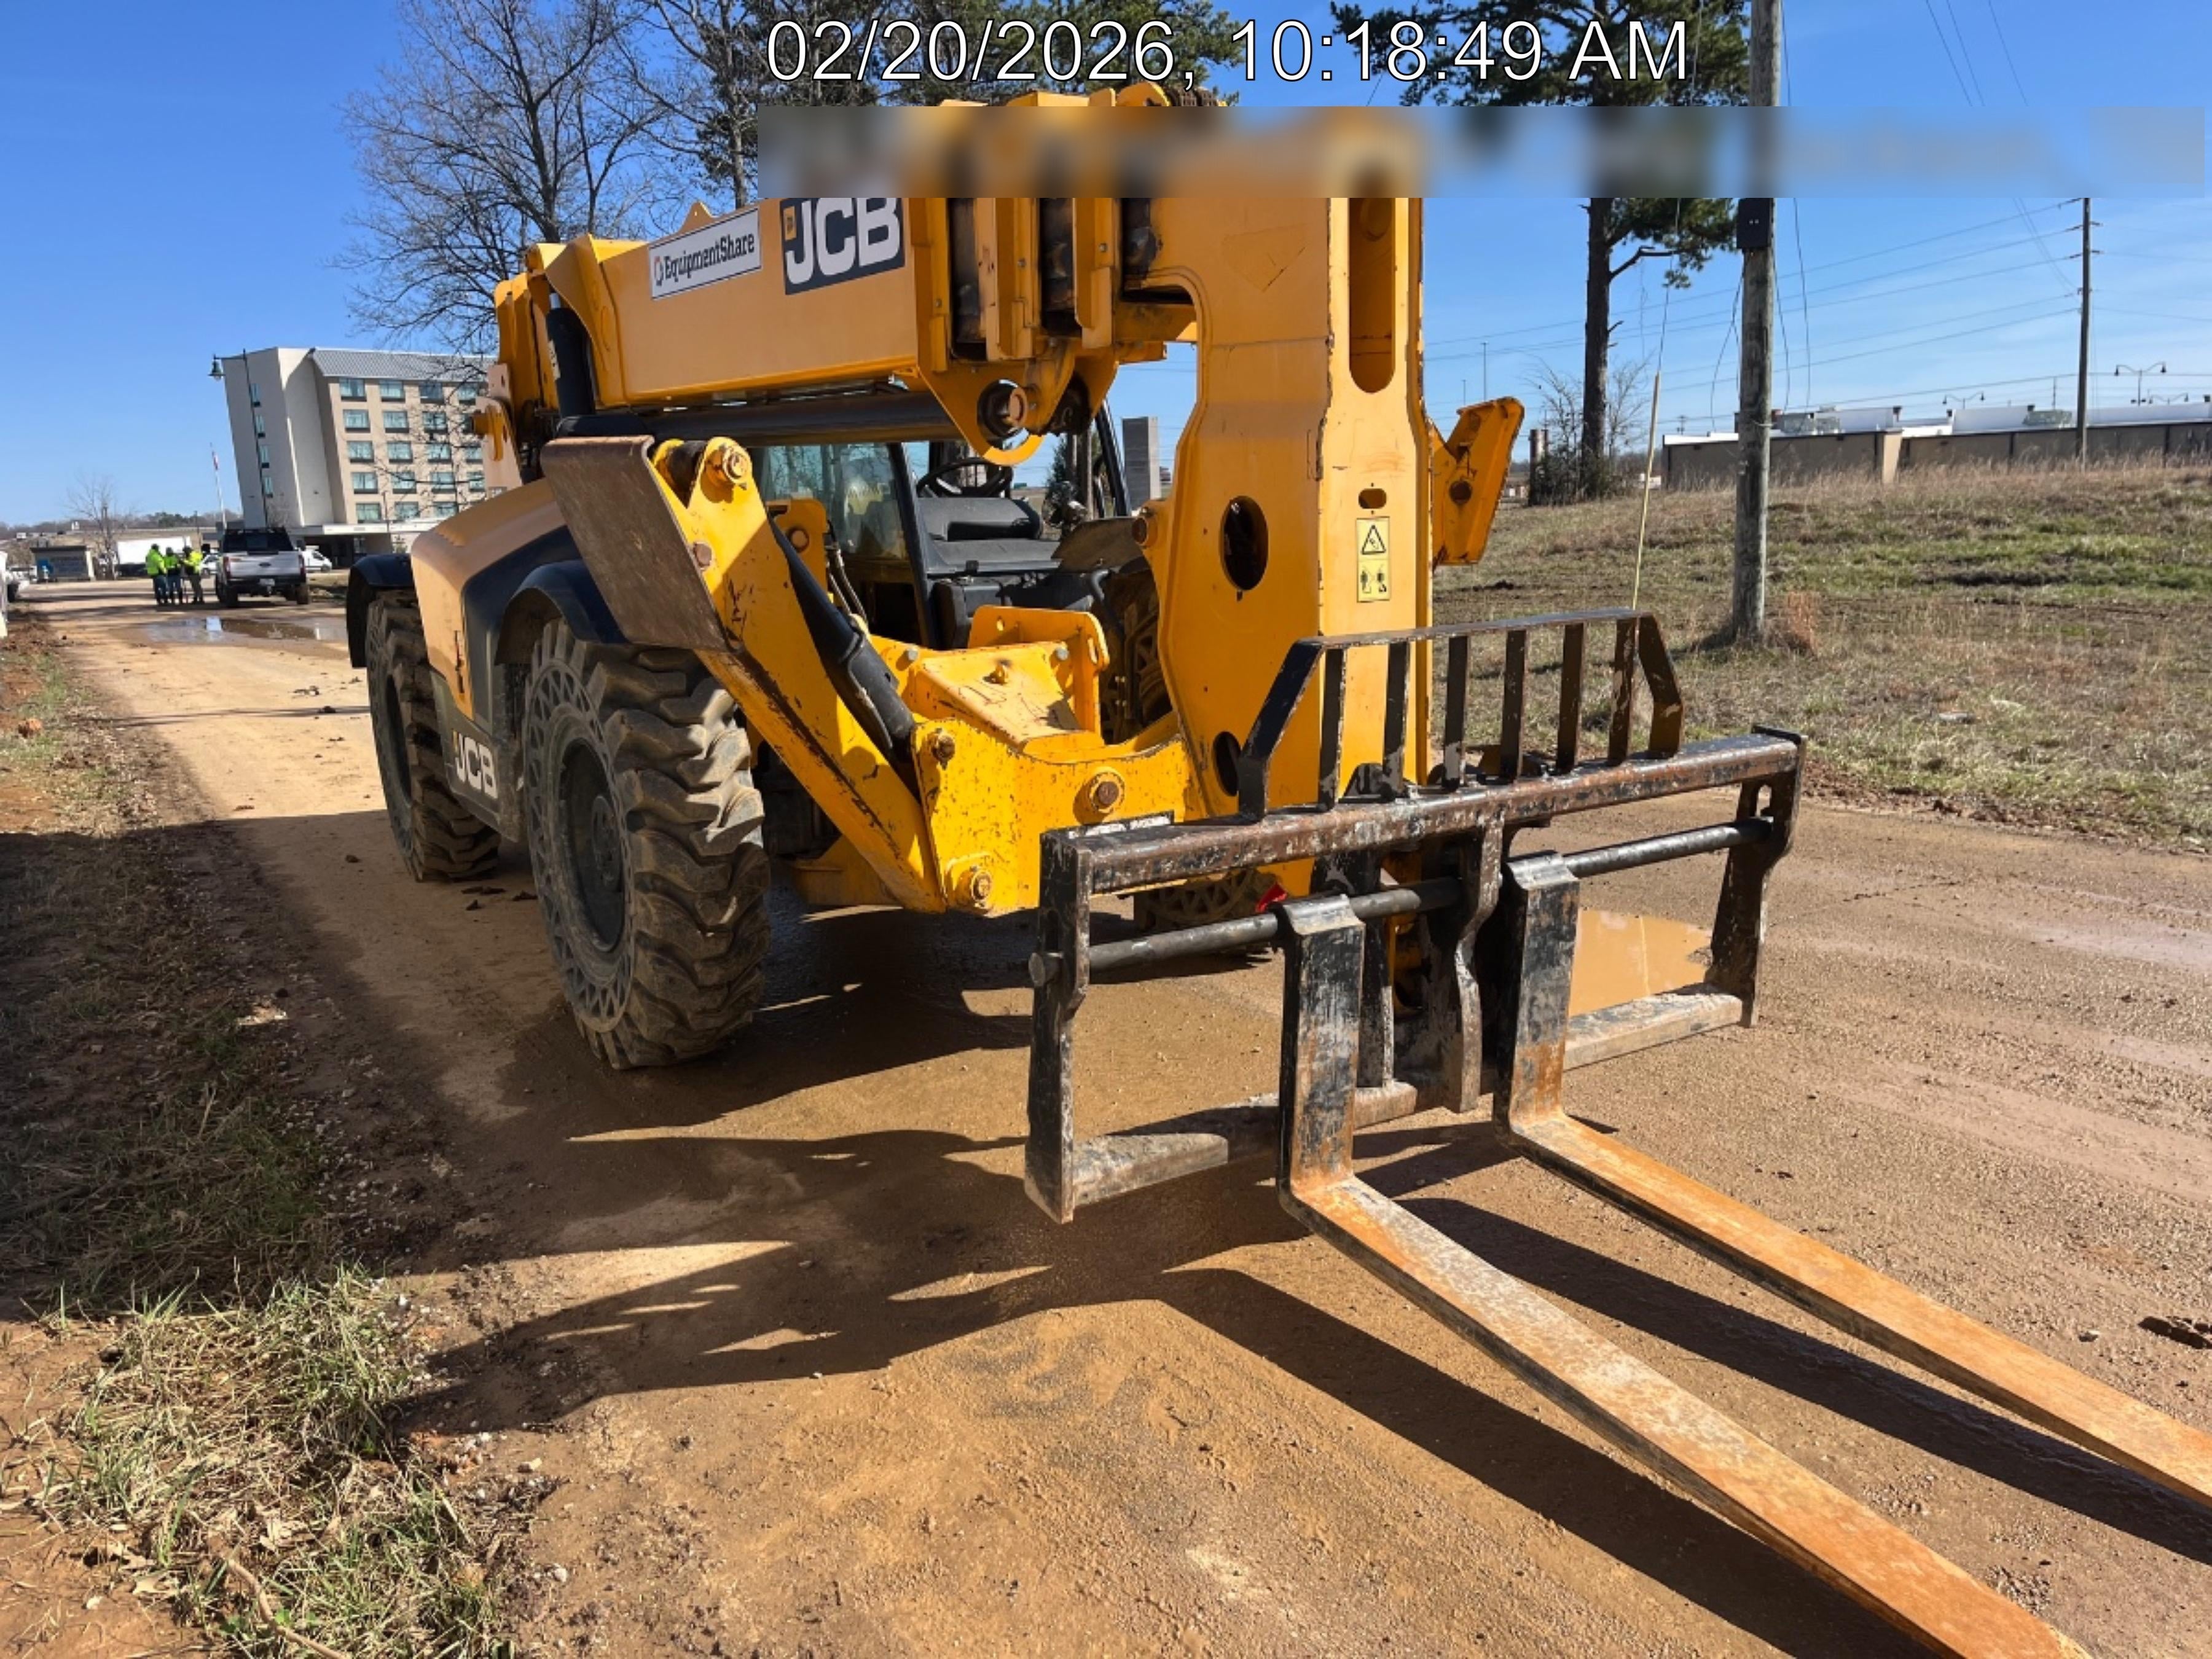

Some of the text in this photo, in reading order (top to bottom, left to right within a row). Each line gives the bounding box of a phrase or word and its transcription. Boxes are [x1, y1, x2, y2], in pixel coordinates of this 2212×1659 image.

[663, 233, 755, 283] EquipmentShare
[785, 198, 901, 284] JCB
[455, 732, 498, 799] JCB
